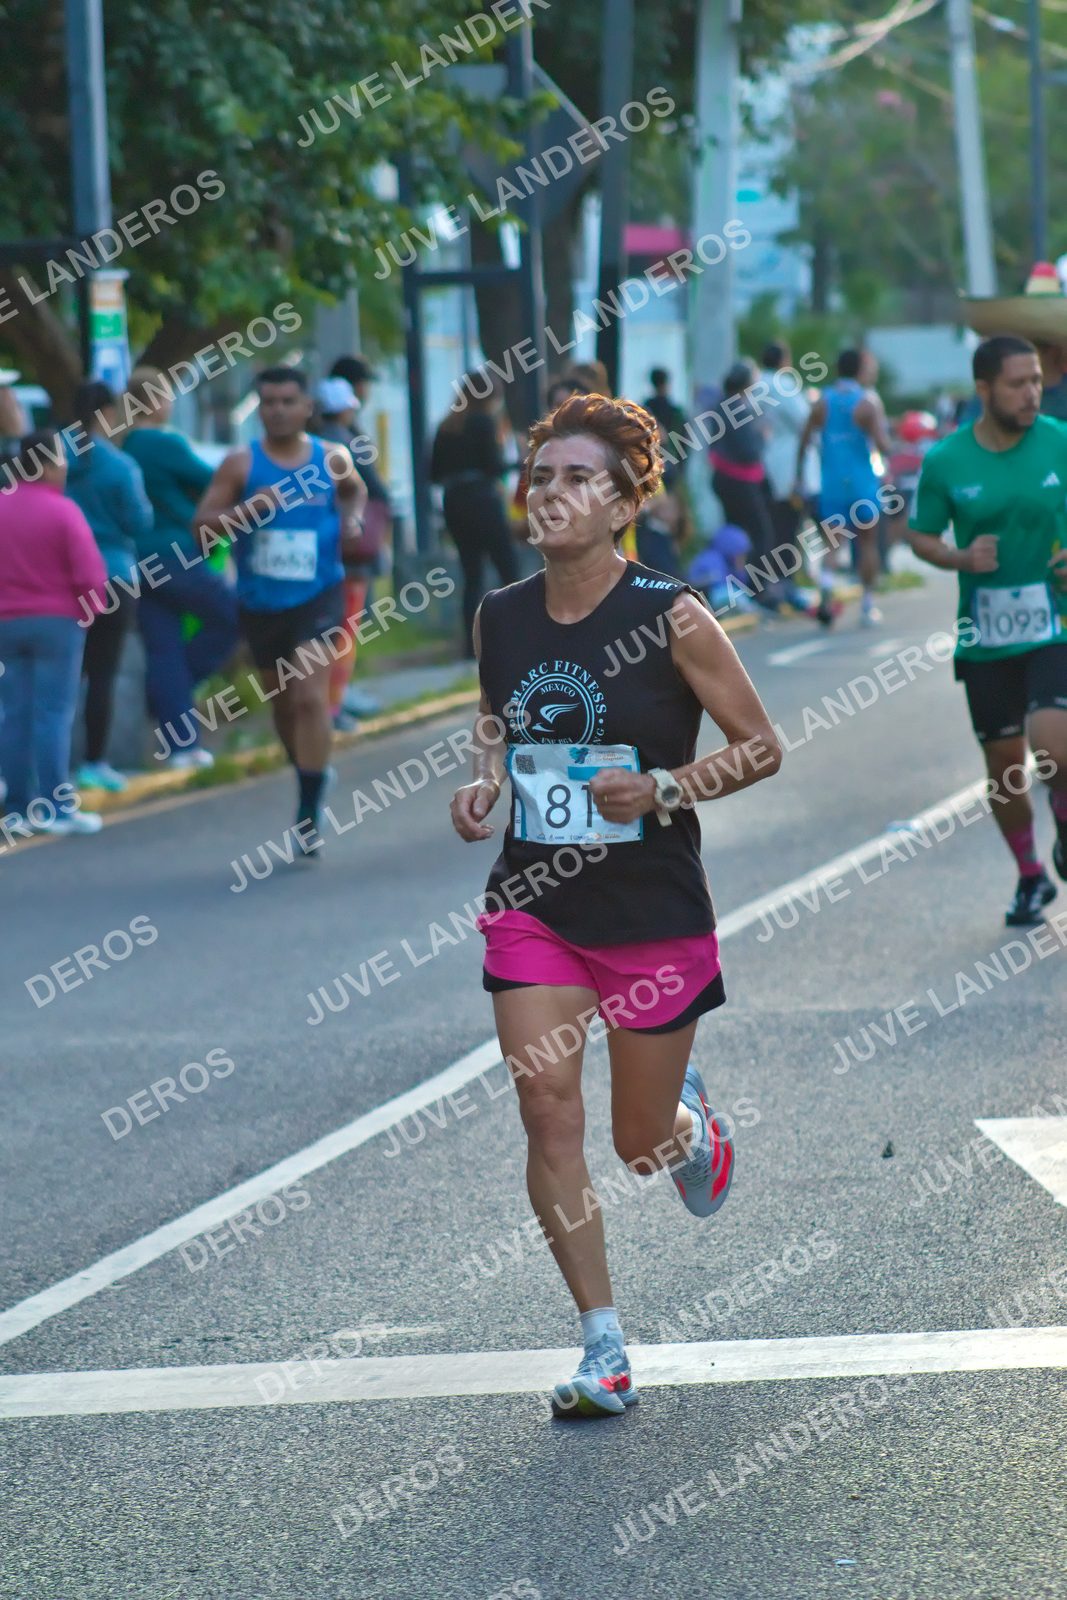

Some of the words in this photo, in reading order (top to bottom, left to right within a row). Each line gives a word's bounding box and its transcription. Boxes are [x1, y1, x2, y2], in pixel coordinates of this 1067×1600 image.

[631, 576, 678, 591] MARC
[982, 607, 1048, 638] 1093
[510, 662, 549, 705] MARC
[554, 660, 607, 714] FITNESS
[540, 683, 576, 698] MEXICO
[545, 784, 593, 829] 81
